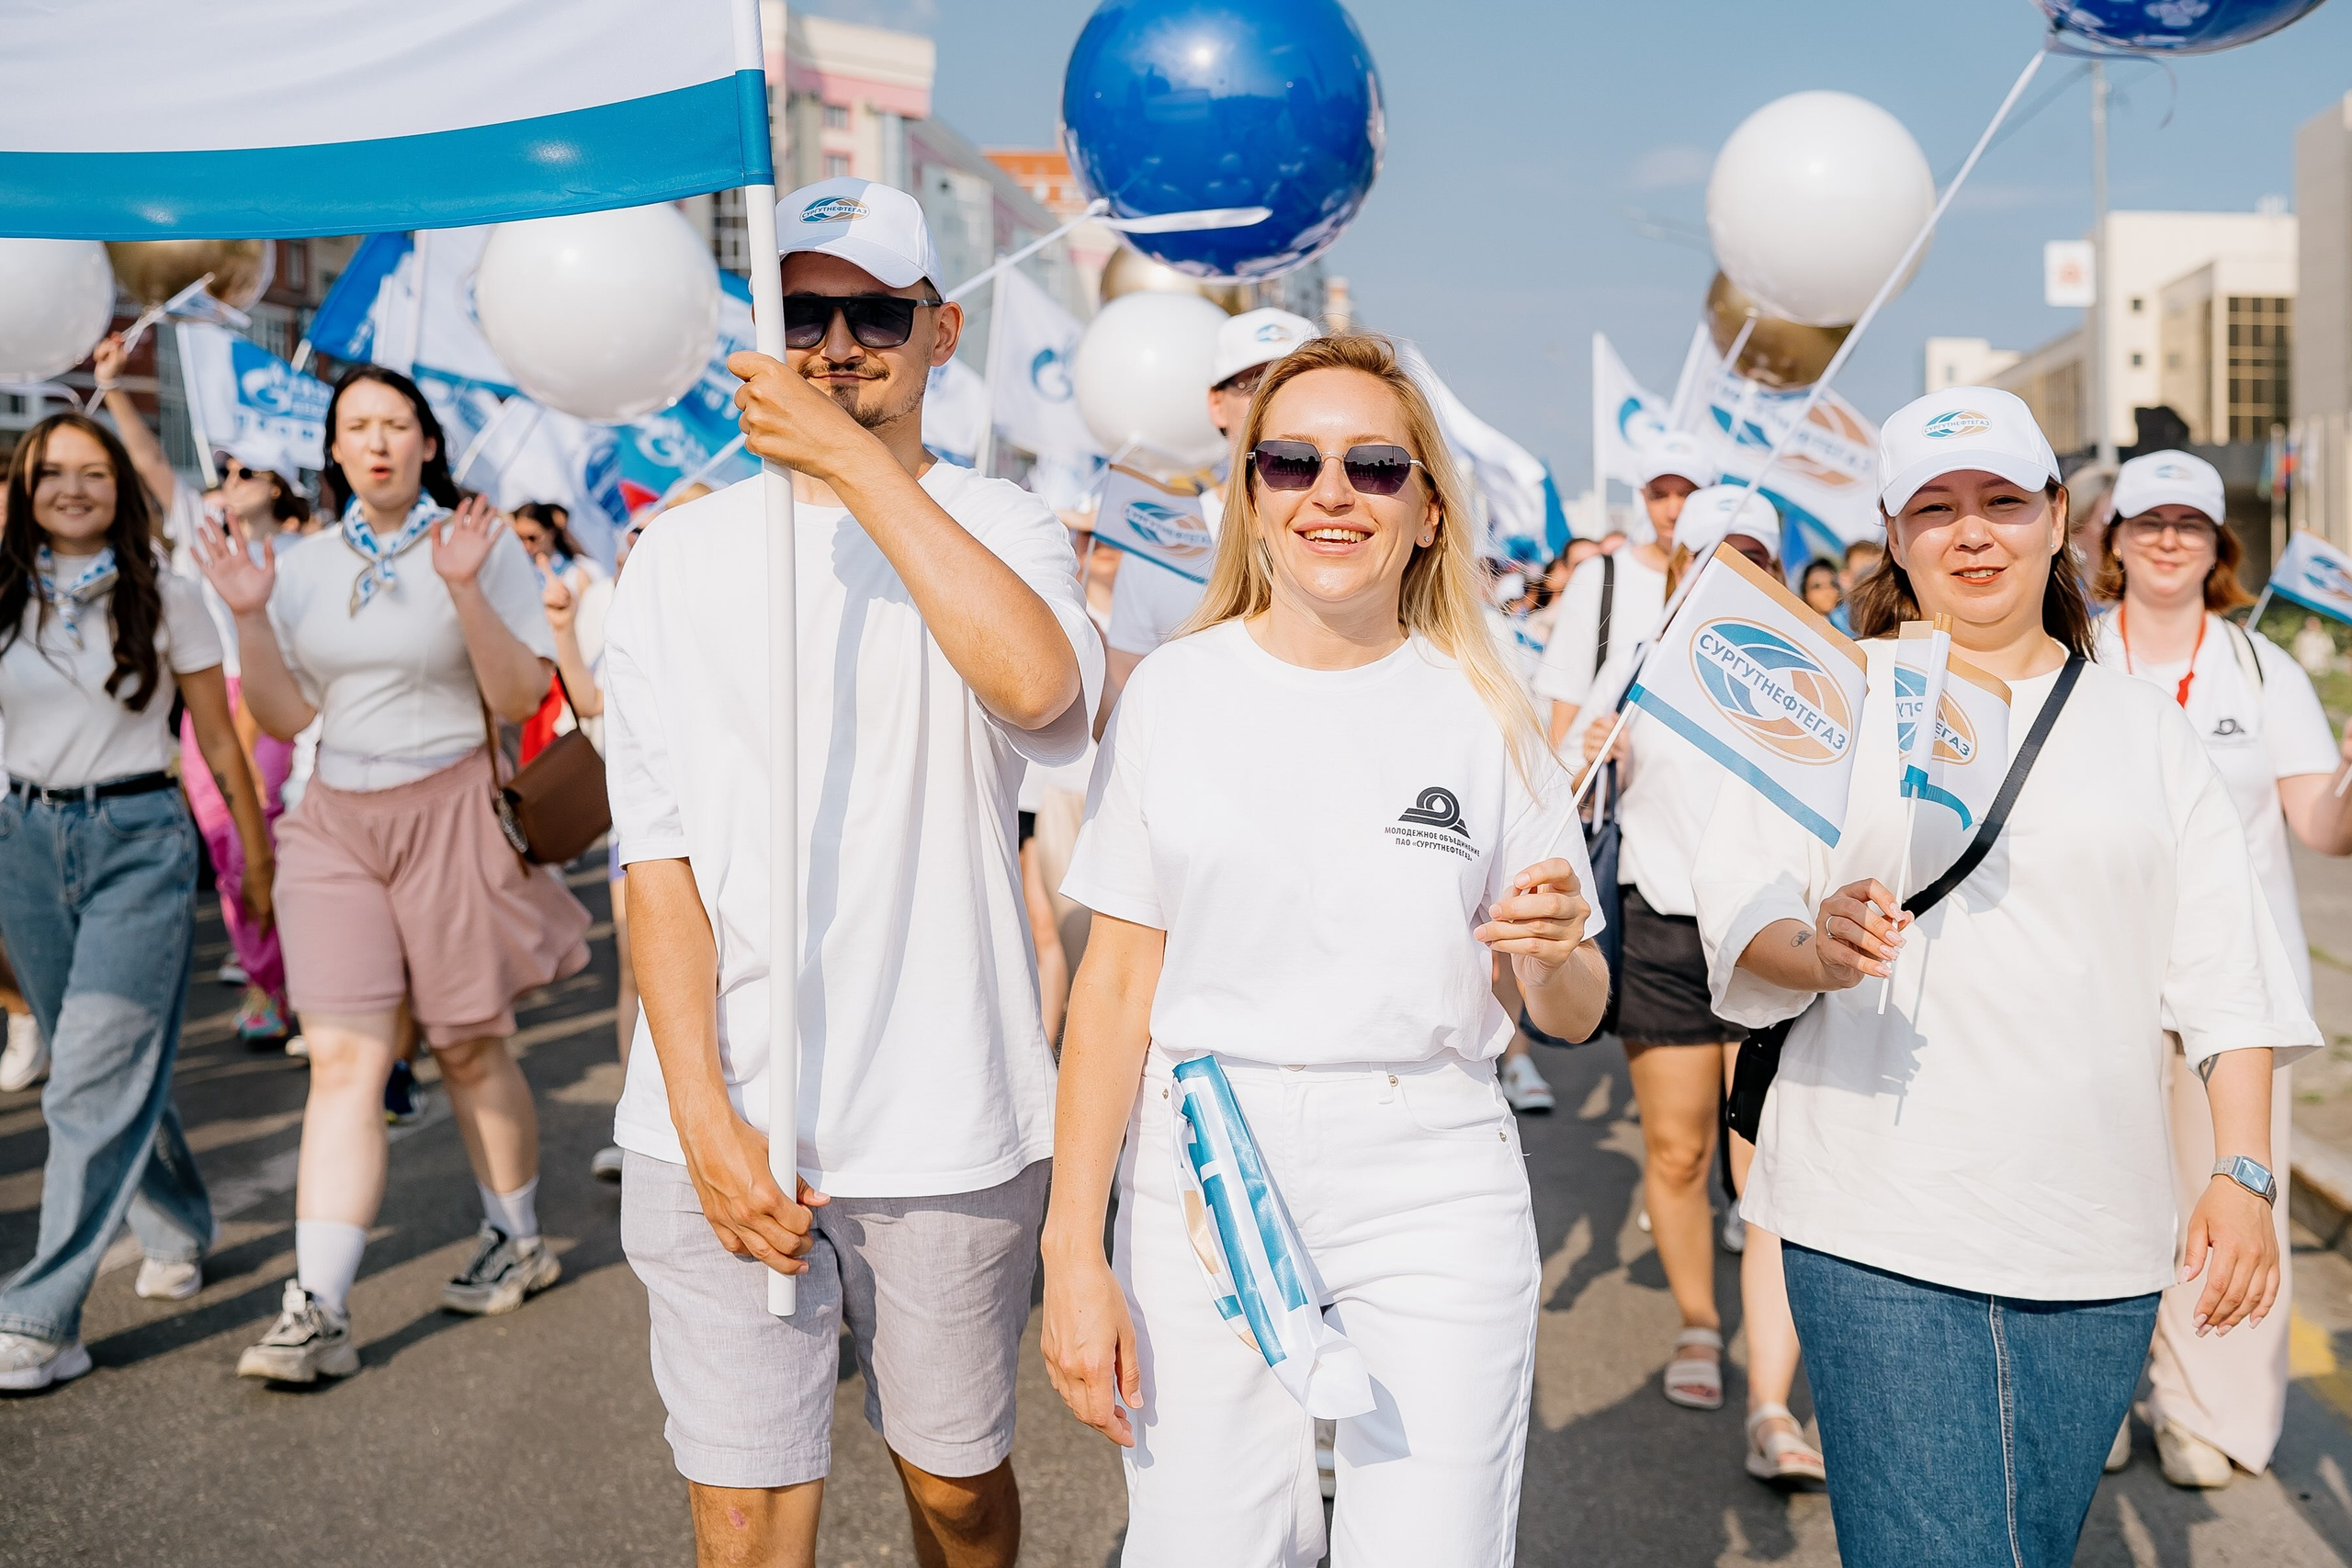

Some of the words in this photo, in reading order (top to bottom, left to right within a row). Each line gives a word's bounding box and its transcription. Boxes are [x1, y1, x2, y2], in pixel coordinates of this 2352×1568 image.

[802, 207, 866, 218] СУРГУТНЕФТЕГАЗ
[1925, 420, 1989, 433] СУРГУТНЕФТЕГАЗ
[1699, 634, 1847, 750] СУРГУТНЕФТЕГАЗ
[1385, 827, 1437, 840] МОЛОДЕЖНОЕ
[1396, 838, 1410, 846] ПАО
